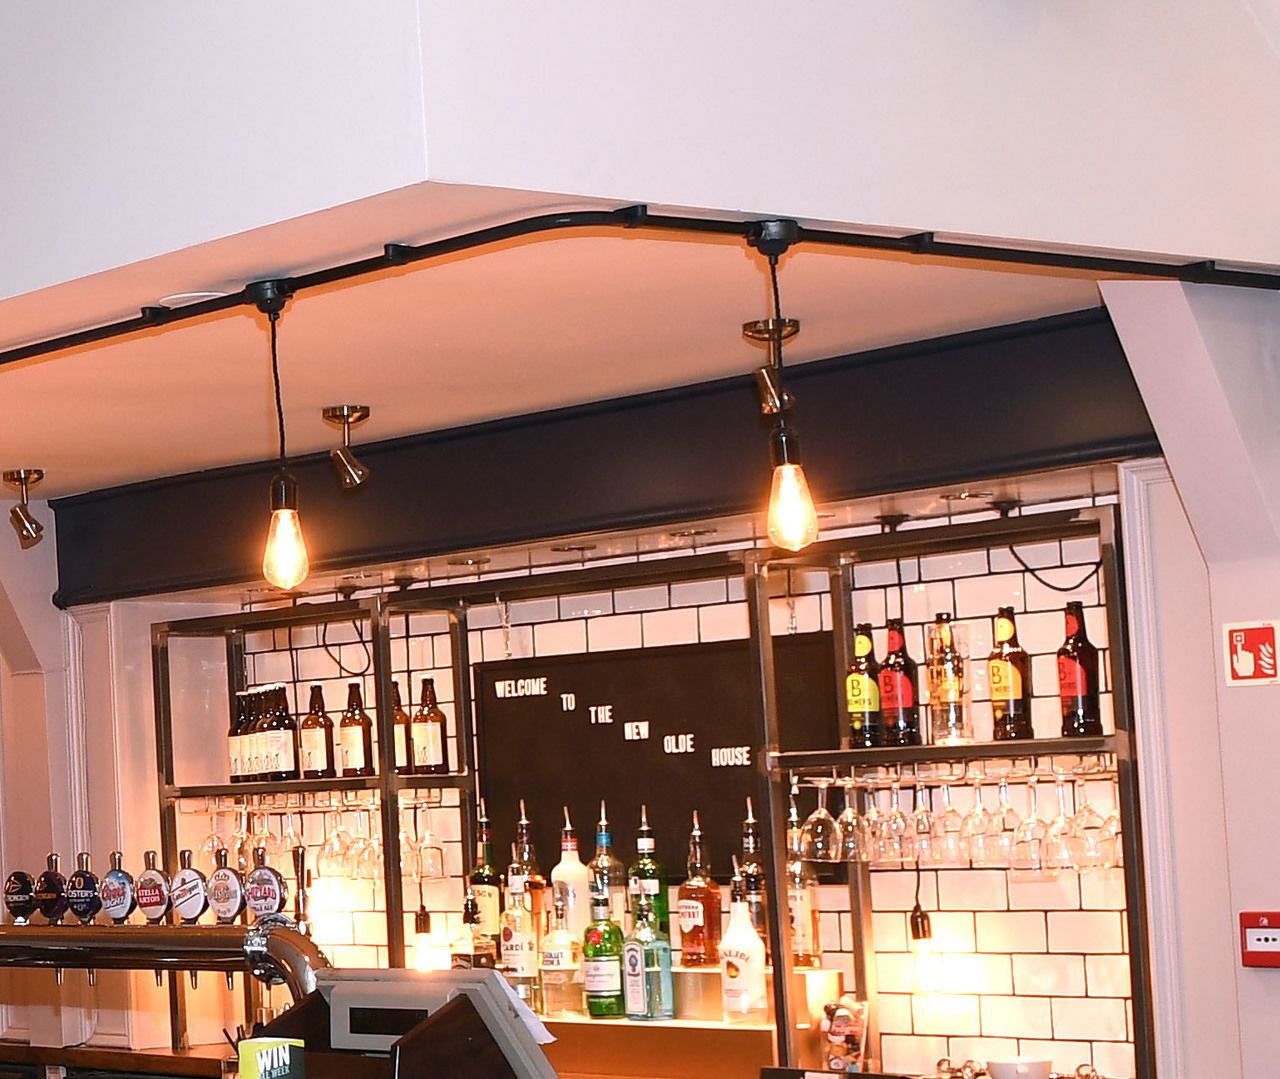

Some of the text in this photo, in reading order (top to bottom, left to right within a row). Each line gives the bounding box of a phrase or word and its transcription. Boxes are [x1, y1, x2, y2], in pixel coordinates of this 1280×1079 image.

[495, 677, 548, 698] WELCOME
[561, 694, 575, 711] TO
[589, 705, 613, 724] THE
[624, 721, 649, 740] NEW
[664, 734, 695, 753] OLDE
[712, 746, 751, 767] HOUSE
[255, 1043, 290, 1072] WIN
